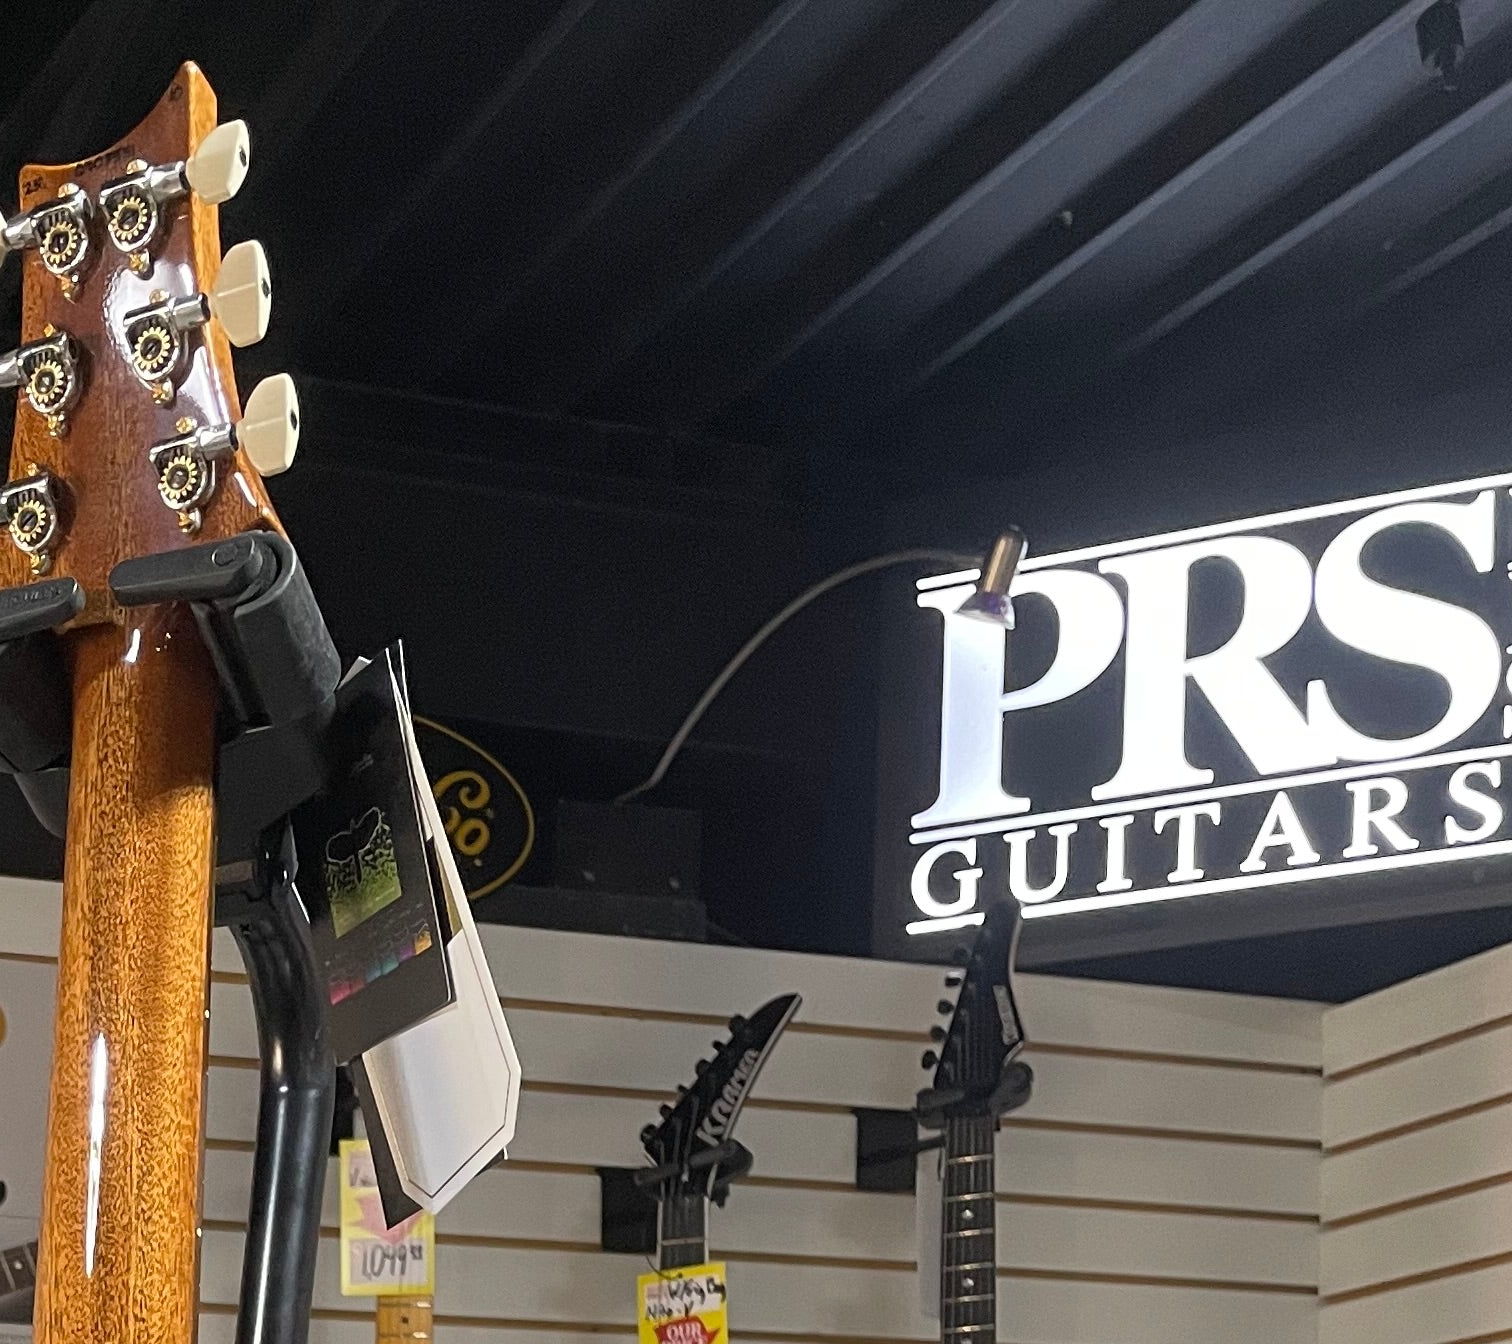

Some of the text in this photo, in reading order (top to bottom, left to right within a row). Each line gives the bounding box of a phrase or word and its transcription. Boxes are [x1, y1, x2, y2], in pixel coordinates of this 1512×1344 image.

[911, 490, 1501, 829] PRS
[910, 760, 1502, 919] GUITARS
[666, 1321, 702, 1342] OUR
